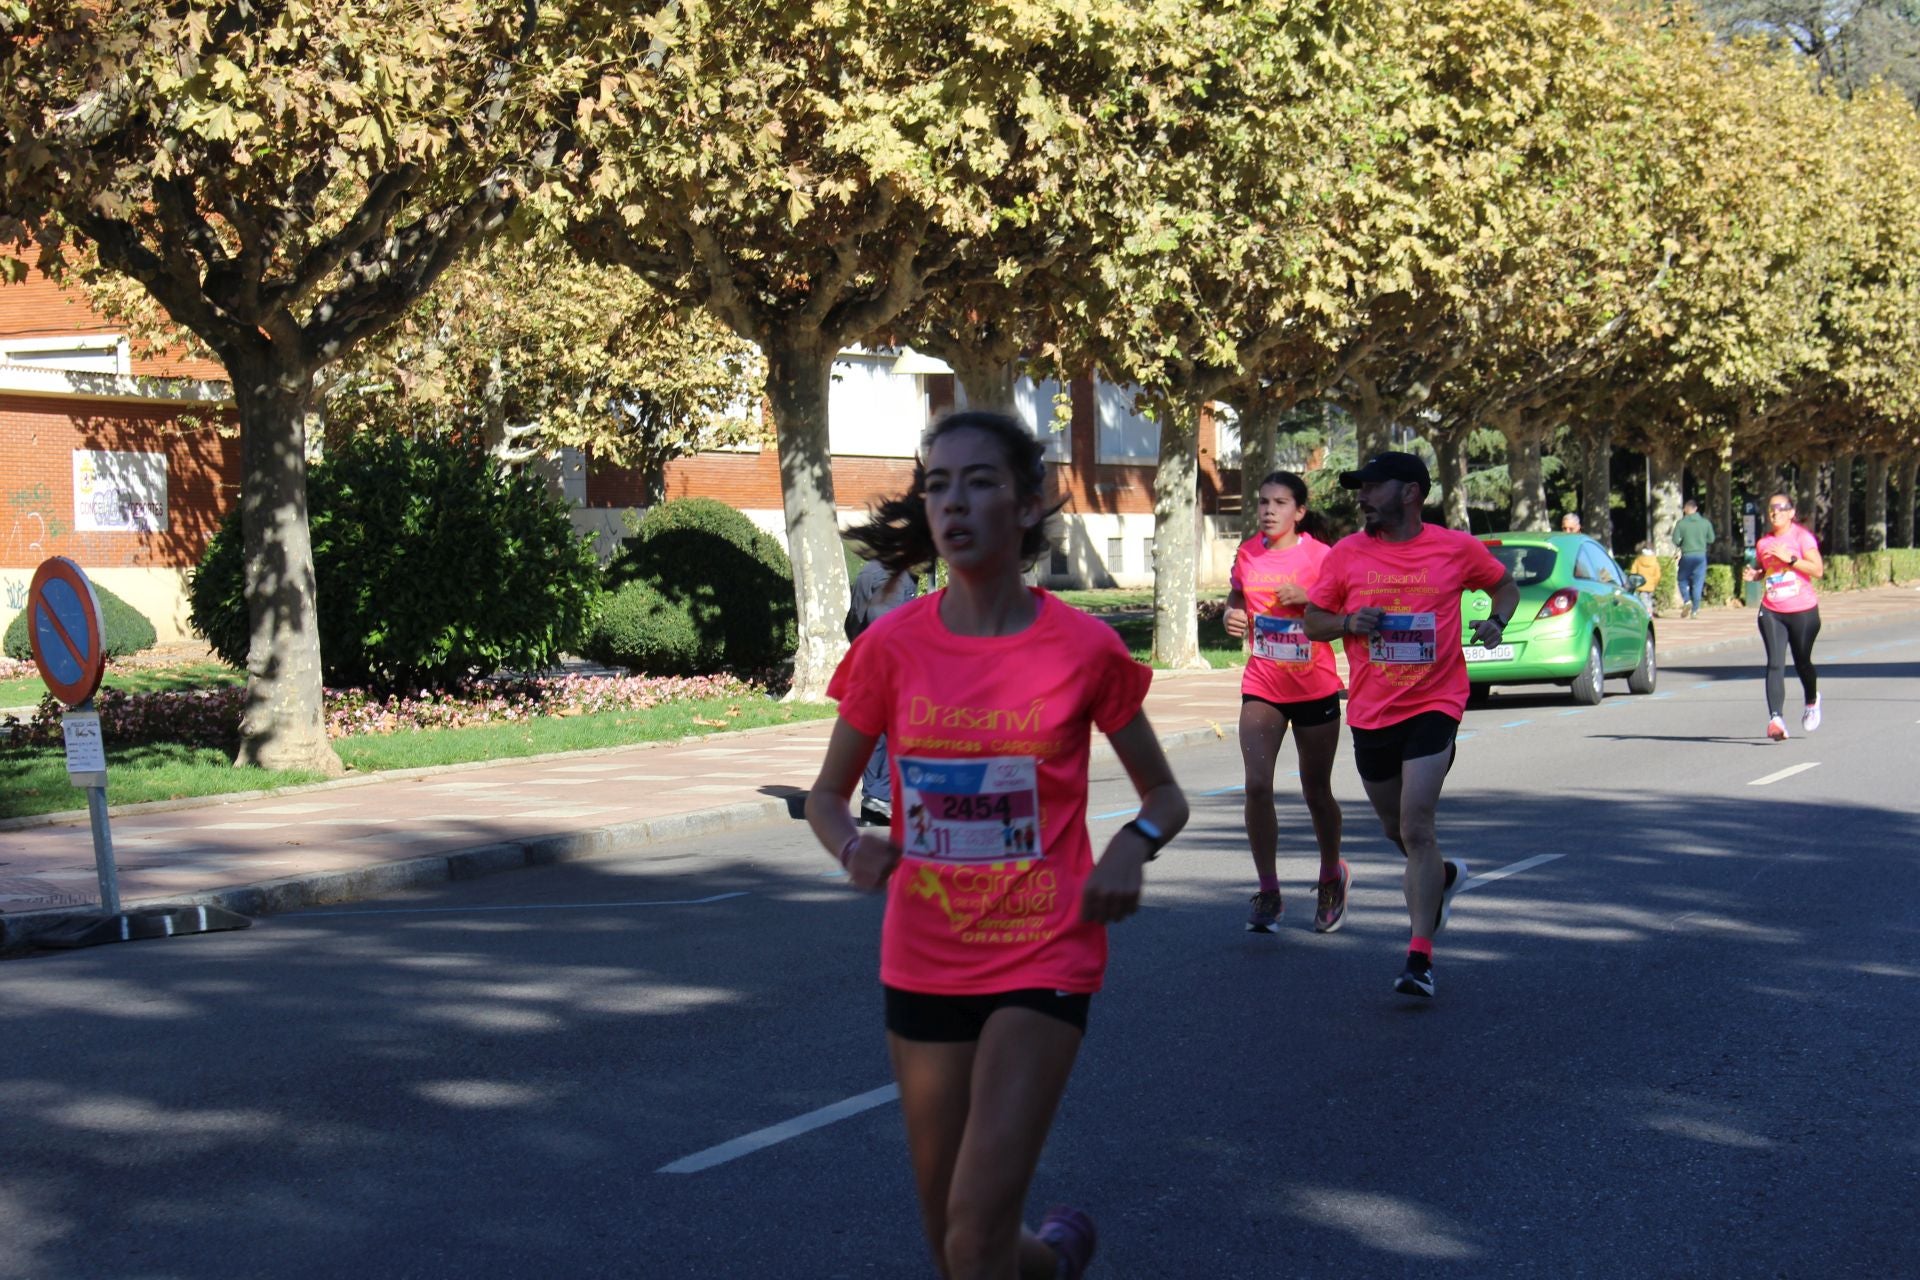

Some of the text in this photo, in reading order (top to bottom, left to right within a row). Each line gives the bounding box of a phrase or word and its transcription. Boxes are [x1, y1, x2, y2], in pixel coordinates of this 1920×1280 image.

[1746, 502, 1753, 513] P
[1272, 632, 1298, 643] 4713
[1391, 630, 1423, 642] 4772
[1267, 645, 1274, 657] 11
[1386, 646, 1395, 659] 11
[943, 795, 1011, 820] 2454
[932, 827, 950, 854] 11
[978, 891, 1057, 916] Mujer
